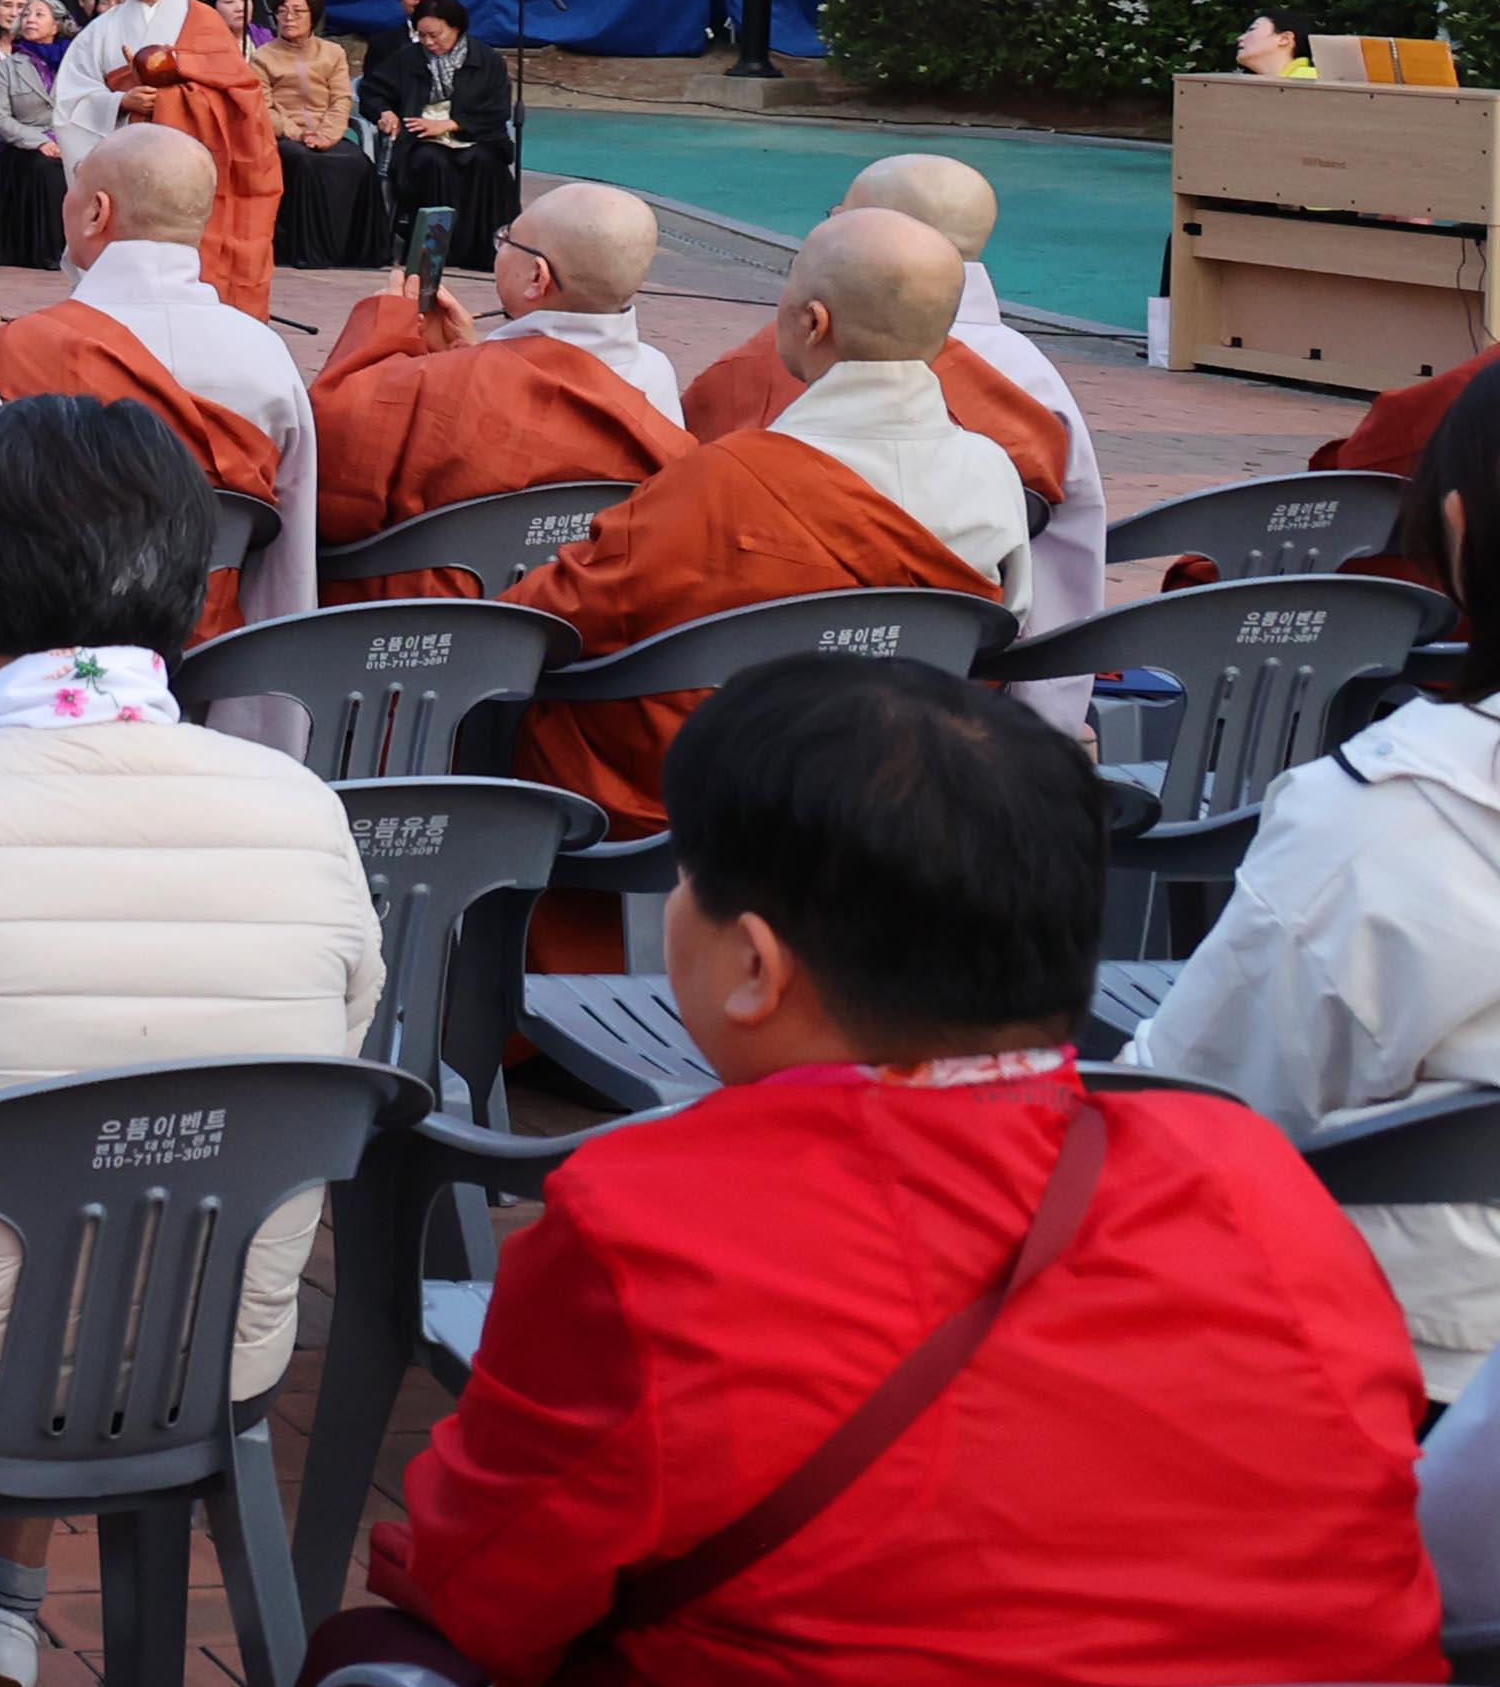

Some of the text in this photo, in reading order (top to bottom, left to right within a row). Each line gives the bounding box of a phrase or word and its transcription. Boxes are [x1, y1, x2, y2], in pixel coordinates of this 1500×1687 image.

[370, 632, 453, 651] 으뜸이벤트
[819, 625, 901, 646] 으뜸이벤트
[97, 1108, 227, 1142] 으뜸이벤트
[91, 1143, 220, 1170] 010-7118-3091
